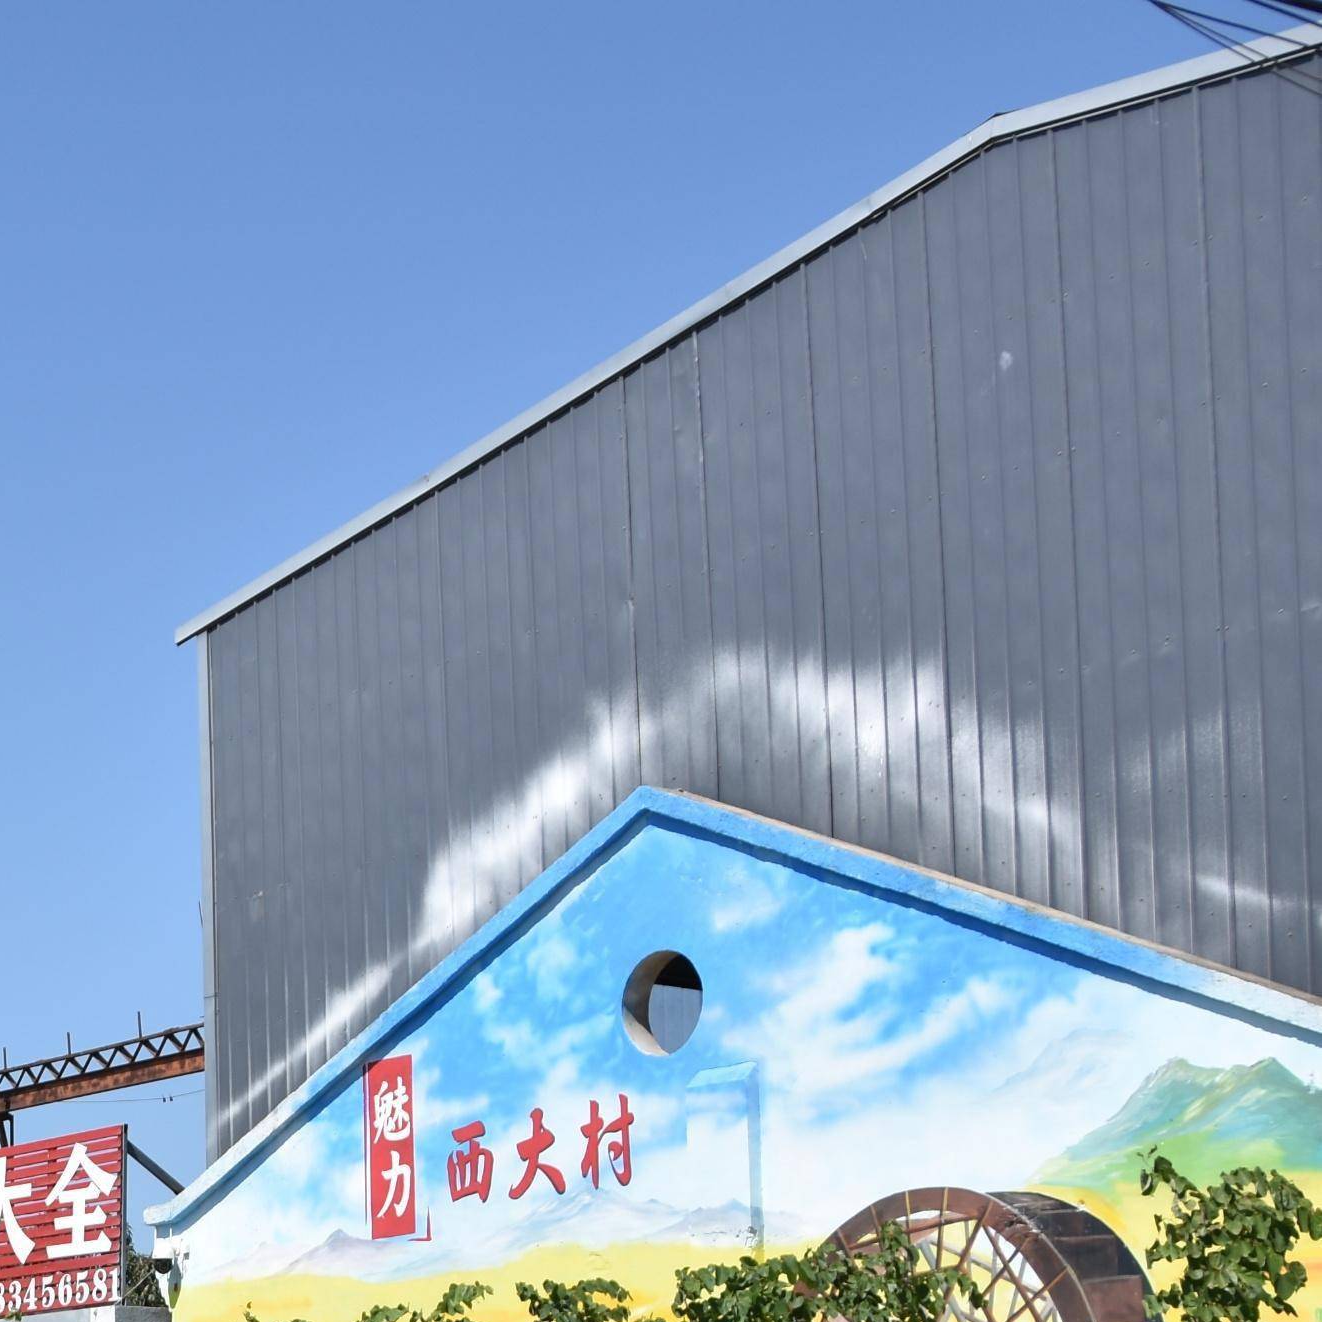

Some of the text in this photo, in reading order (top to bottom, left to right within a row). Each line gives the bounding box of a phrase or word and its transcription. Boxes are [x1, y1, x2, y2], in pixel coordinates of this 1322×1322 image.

[373, 1075, 412, 1219] 魅力
[446, 1092, 635, 1204] 西大村
